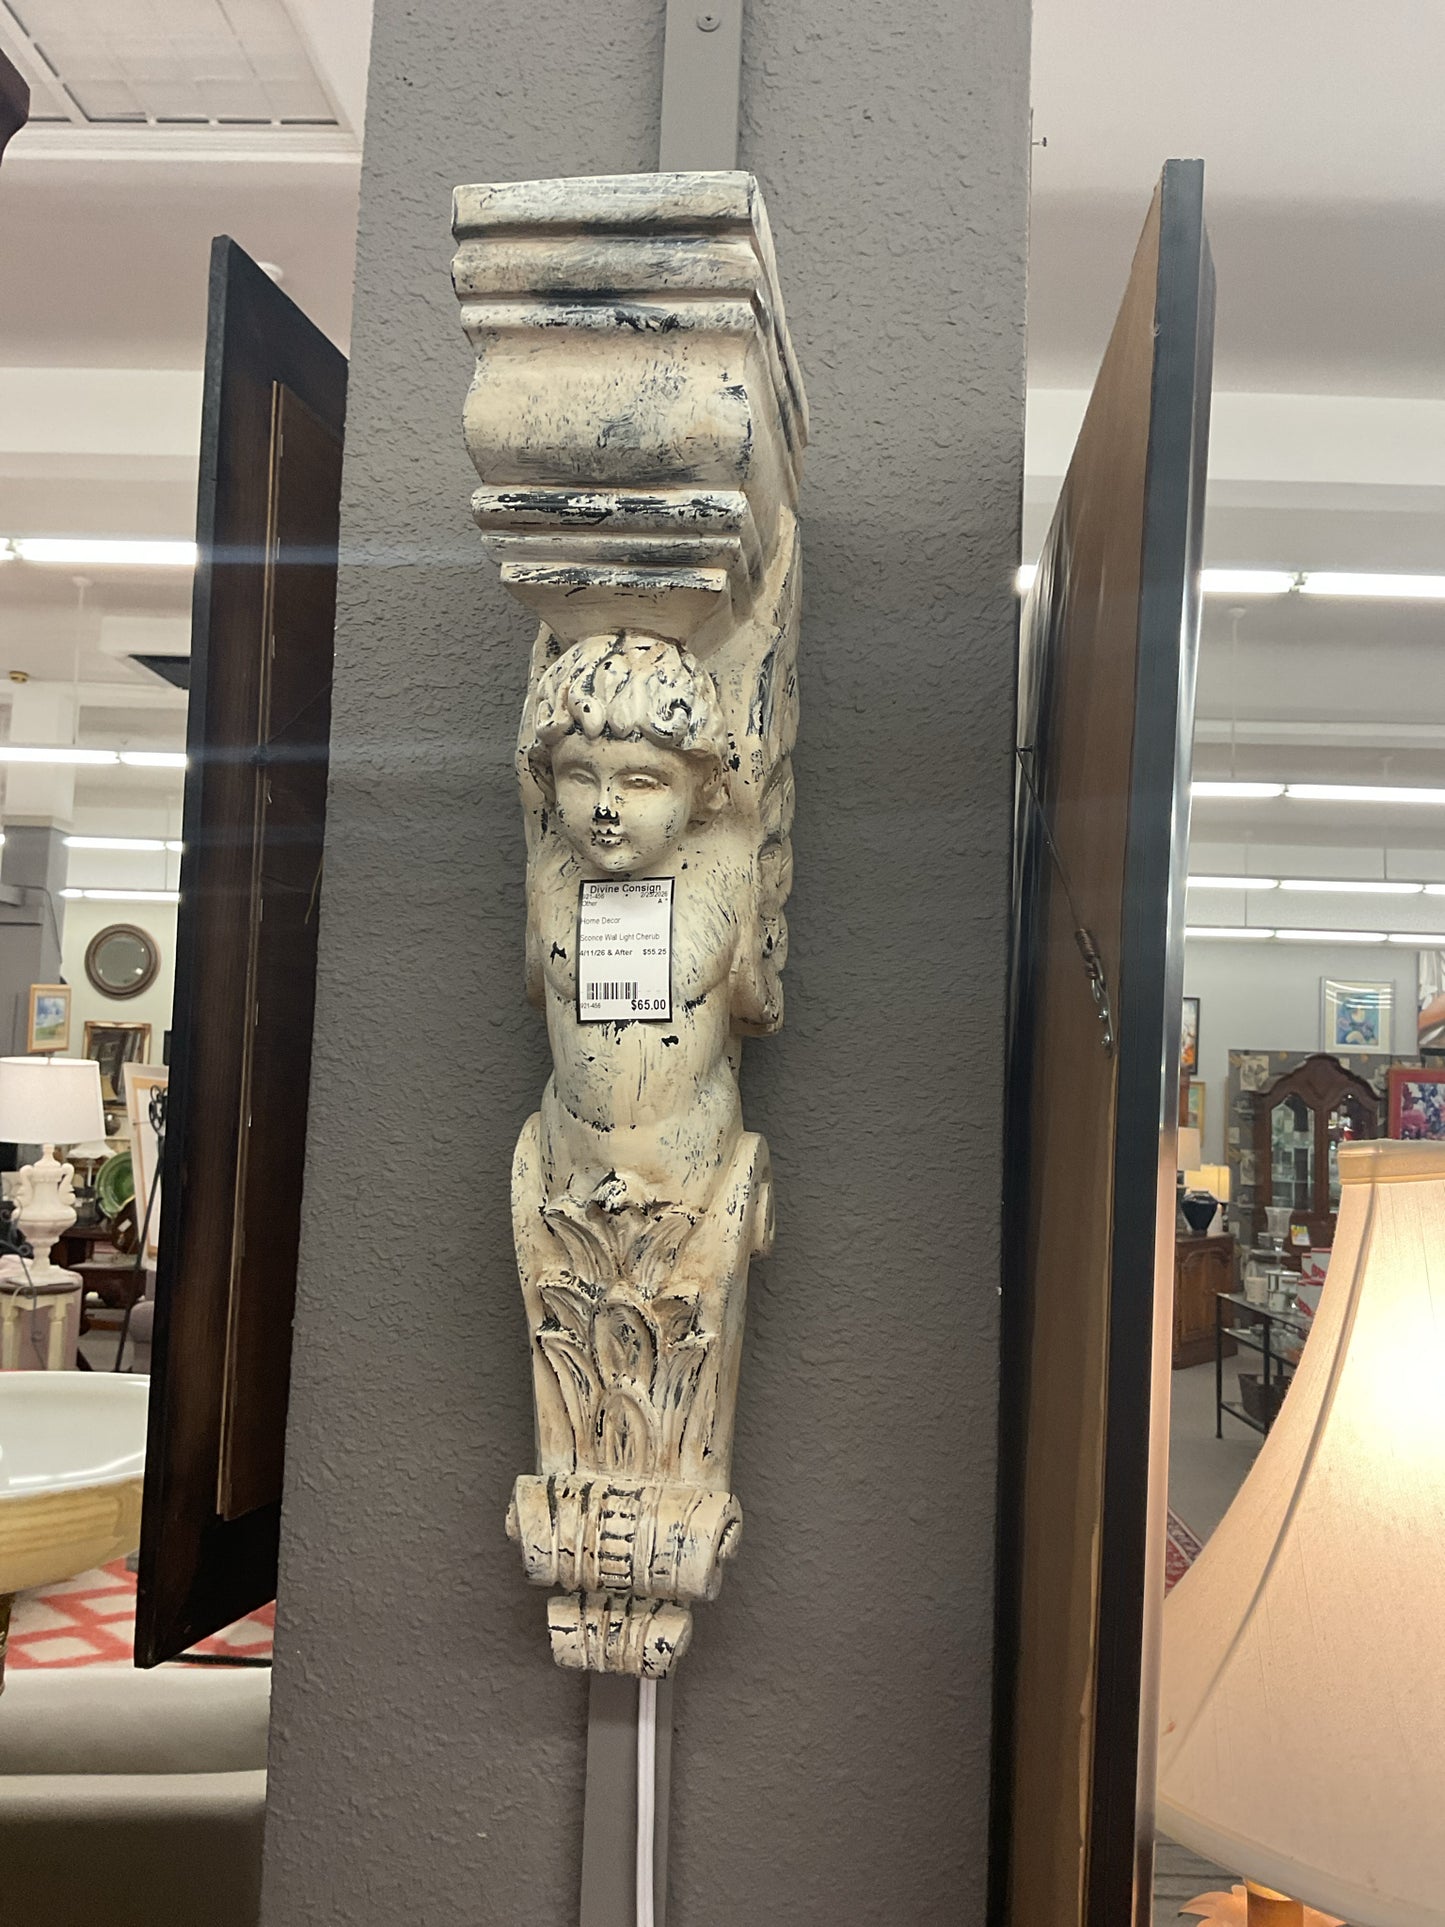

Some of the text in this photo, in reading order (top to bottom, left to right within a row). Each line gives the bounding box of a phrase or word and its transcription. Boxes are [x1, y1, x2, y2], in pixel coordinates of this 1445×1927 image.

[590, 883, 661, 894] Divine Consign
[620, 933, 634, 942] Light
[631, 999, 666, 1010] $65.00
